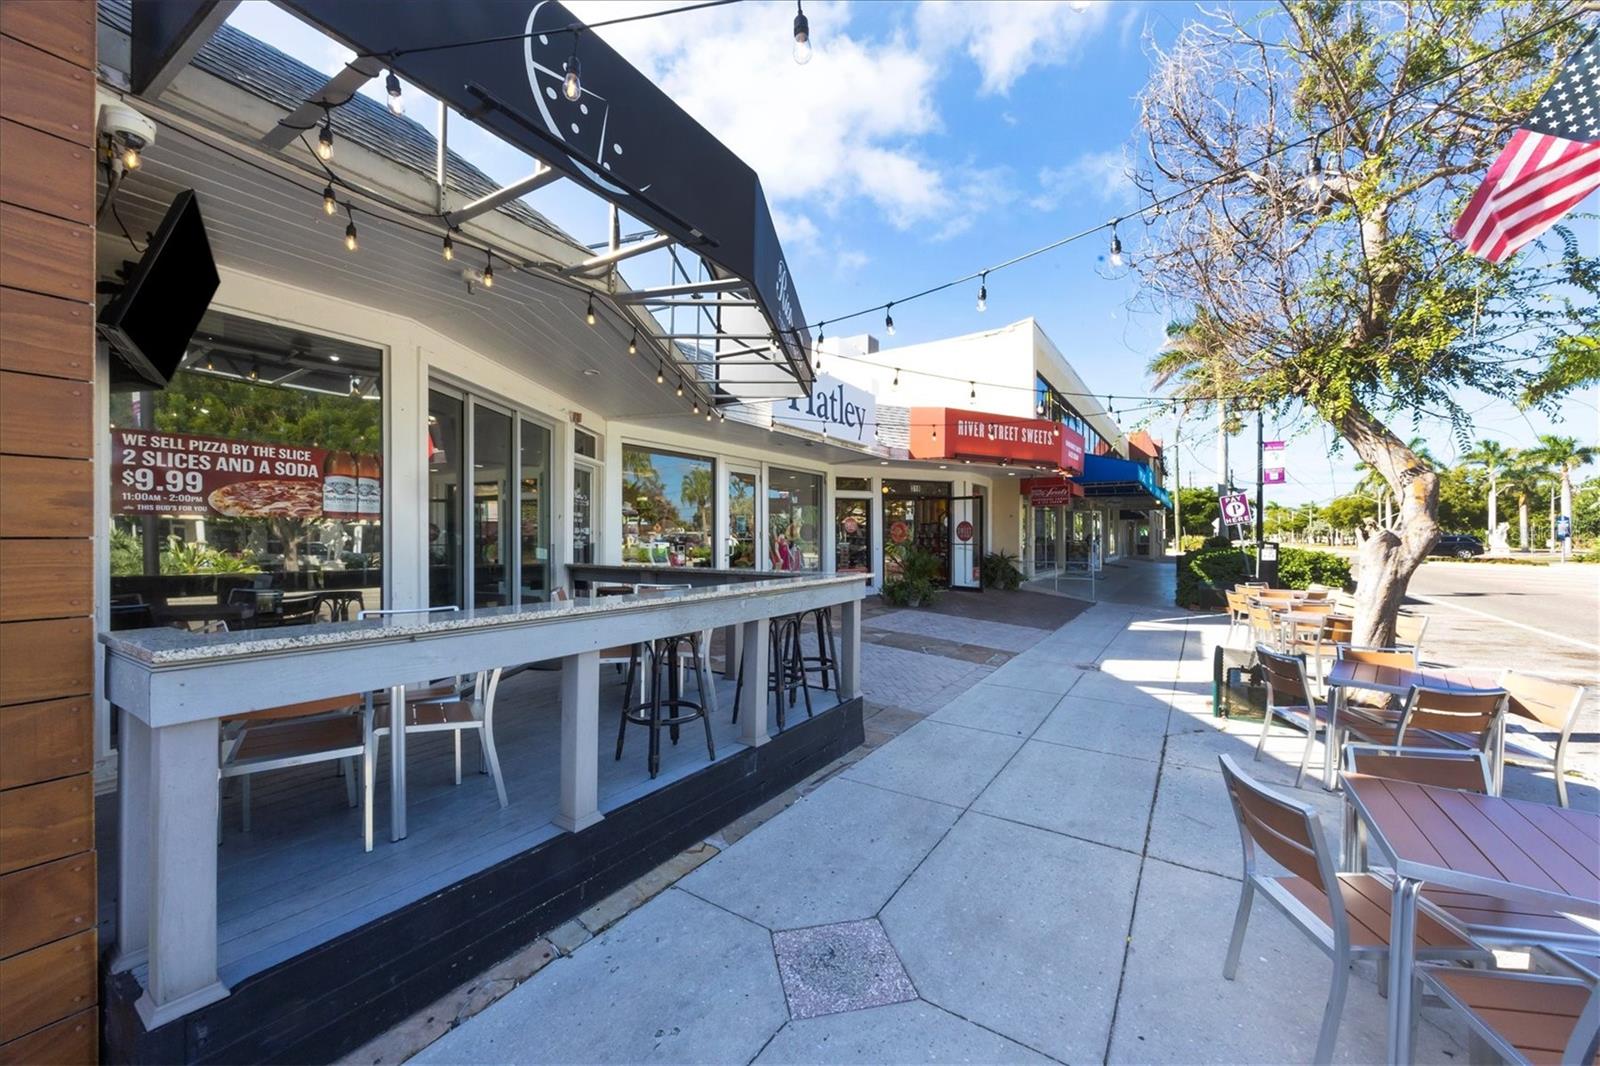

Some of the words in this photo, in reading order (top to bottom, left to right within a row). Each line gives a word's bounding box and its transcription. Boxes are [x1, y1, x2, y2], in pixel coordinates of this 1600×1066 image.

[958, 420, 985, 438] RIVER
[988, 423, 1018, 442] STREET
[122, 433, 147, 447] WE
[150, 435, 185, 450] SELL
[189, 439, 228, 454] PIZZA
[232, 444, 249, 455] BY
[252, 445, 276, 458] THE
[278, 448, 311, 461] SLICE
[122, 449, 136, 465] 2
[142, 450, 211, 470] SLICES
[216, 456, 255, 473] AND
[259, 460, 271, 474] A
[274, 461, 318, 478] SODA
[121, 467, 203, 493] $9.99
[122, 492, 161, 501] 11:00AM
[169, 494, 203, 503] 2:00PM
[1225, 495, 1242, 504] PAY
[1232, 504, 1241, 515] P
